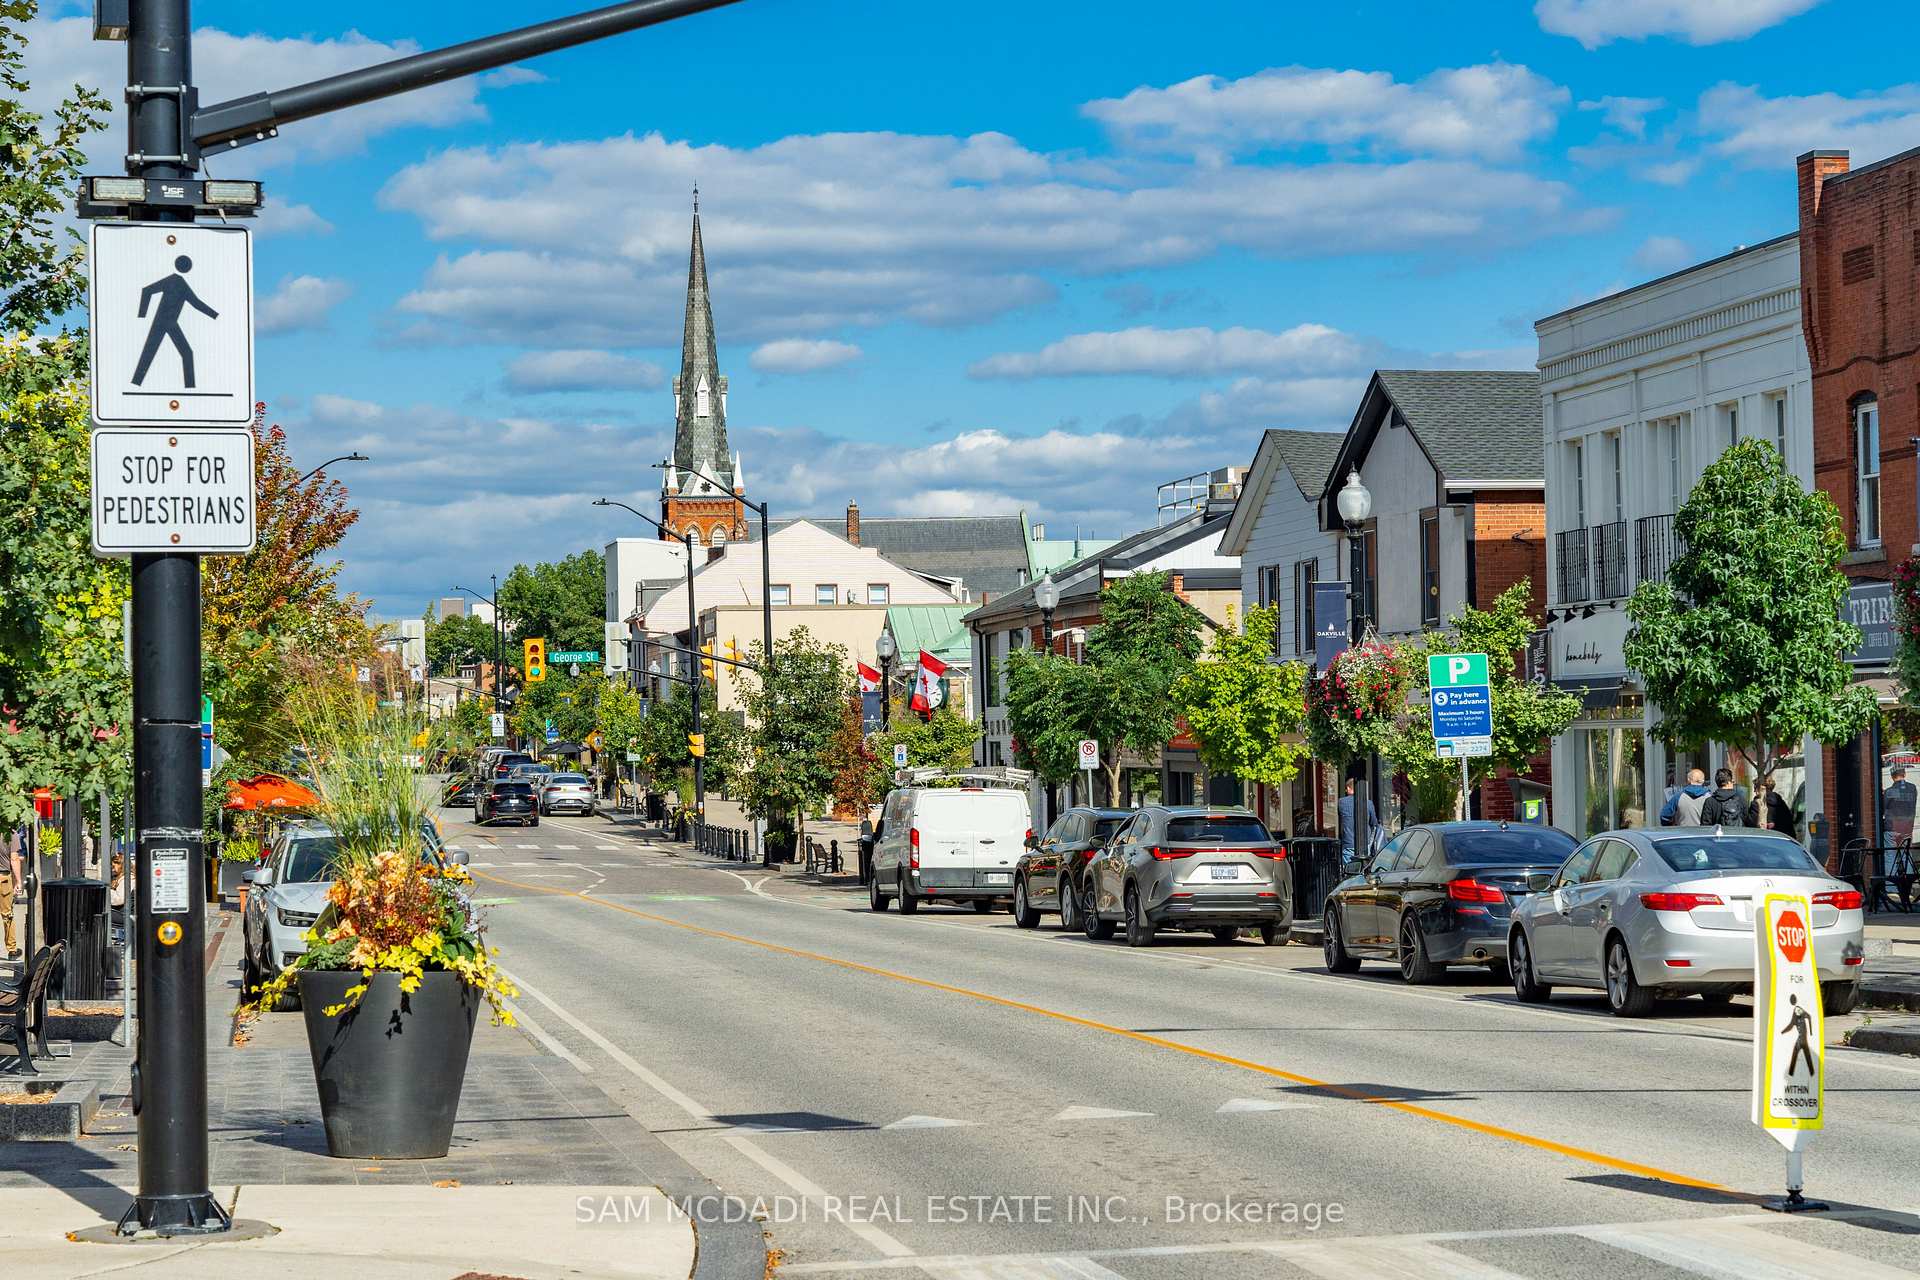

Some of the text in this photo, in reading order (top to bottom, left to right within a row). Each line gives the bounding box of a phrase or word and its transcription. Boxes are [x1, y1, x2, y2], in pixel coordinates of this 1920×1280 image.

[122, 455, 226, 484] STOP FOR
[103, 496, 245, 525] PEDESTRIANS
[554, 652, 594, 663] George St
[1449, 657, 1471, 684] P
[1450, 692, 1463, 700] Pay
[1778, 926, 1805, 947] STOP
[1790, 975, 1804, 984] FOR
[1784, 1085, 1809, 1094] WITHIN
[1773, 1098, 1818, 1107] CROSSOVER
